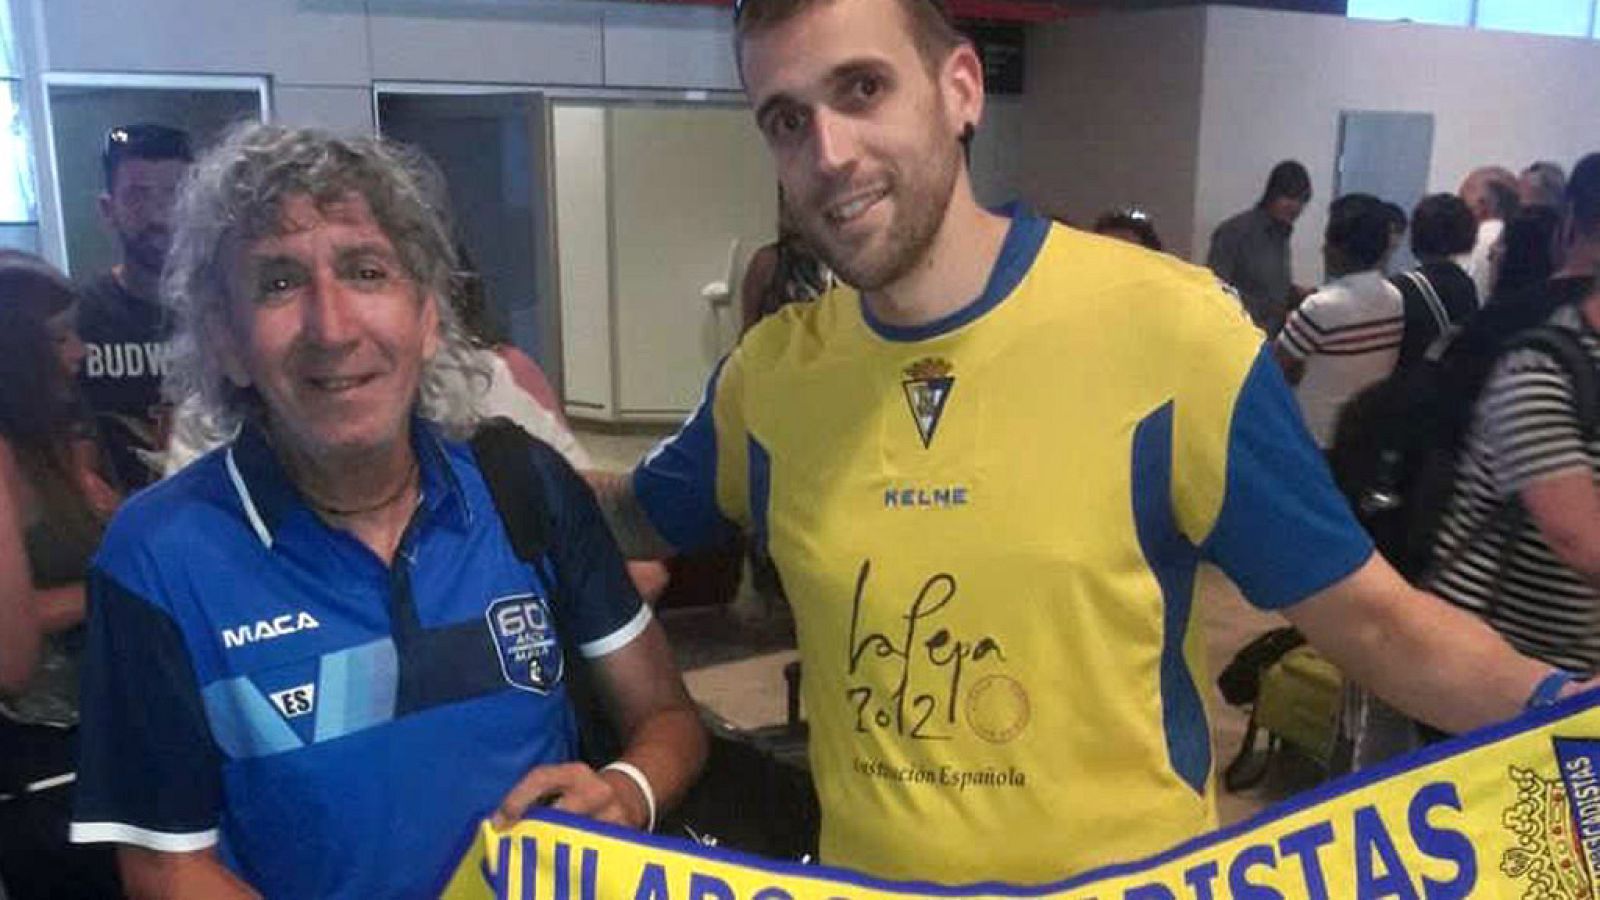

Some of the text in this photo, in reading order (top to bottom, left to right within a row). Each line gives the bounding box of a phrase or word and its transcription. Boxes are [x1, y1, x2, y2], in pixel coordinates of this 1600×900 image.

[884, 487, 968, 507] KELME
[222, 611, 320, 648] MACA
[281, 690, 310, 714] ES
[939, 765, 1027, 792] Española
